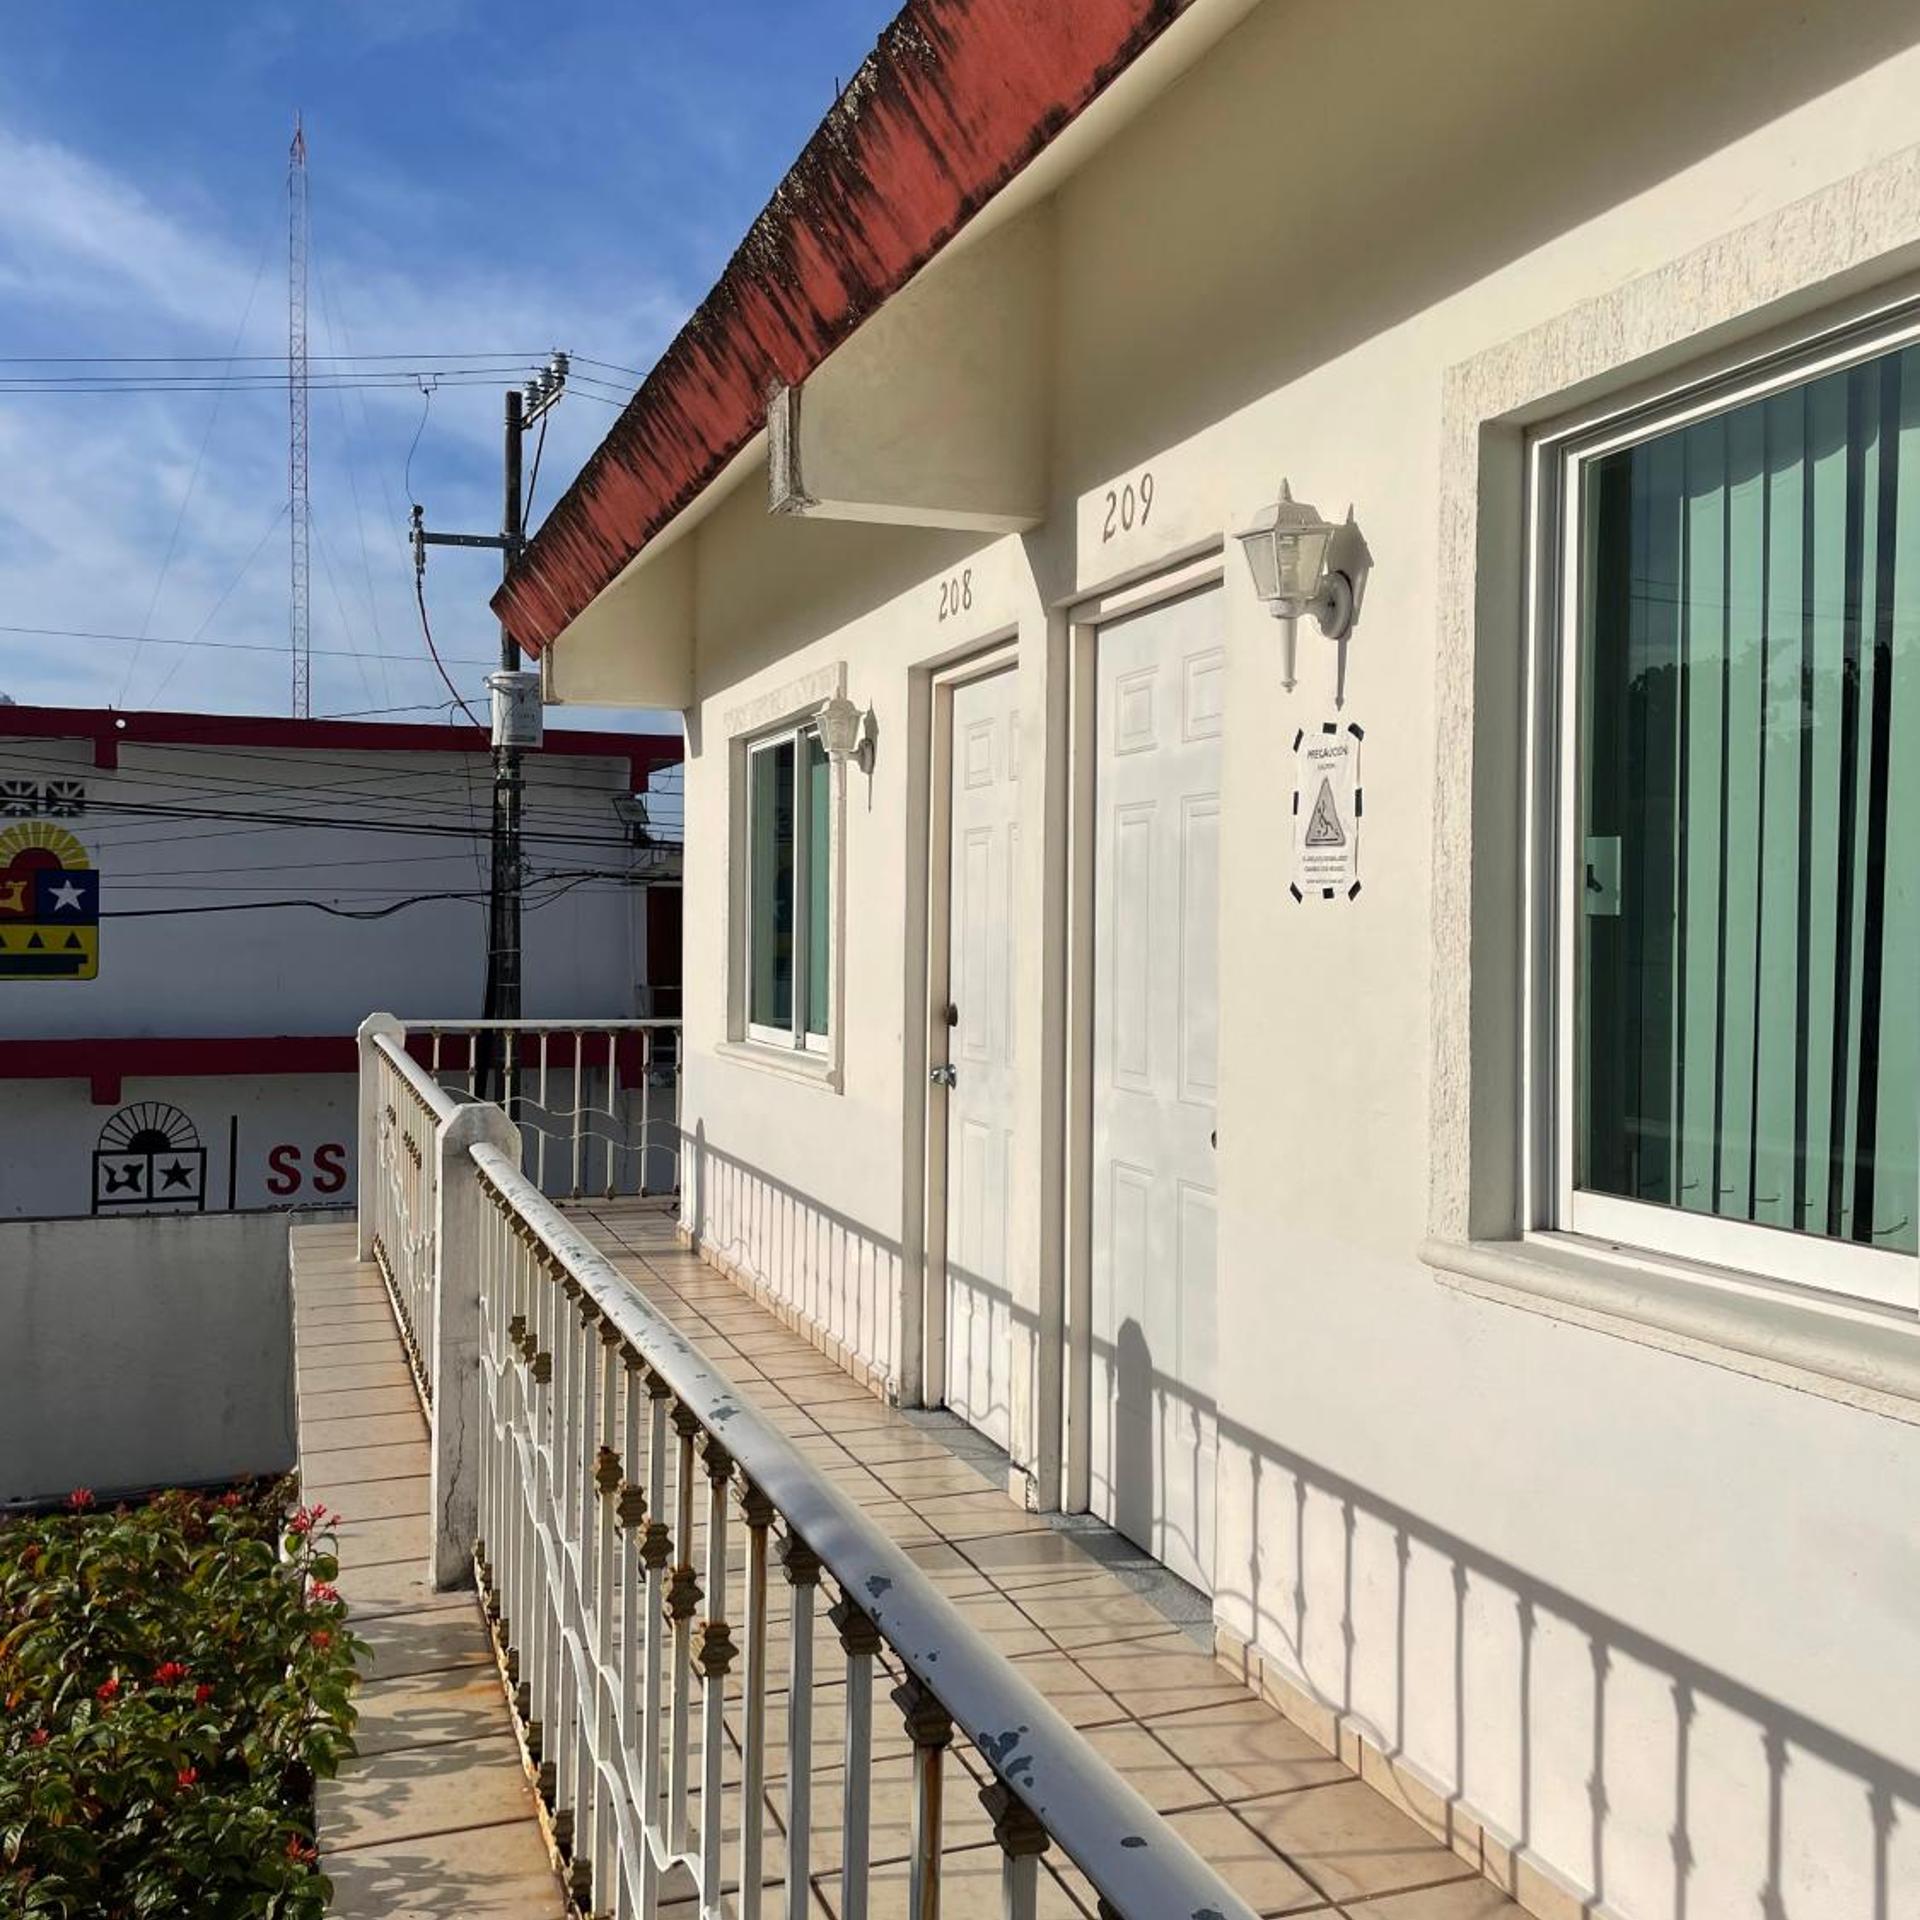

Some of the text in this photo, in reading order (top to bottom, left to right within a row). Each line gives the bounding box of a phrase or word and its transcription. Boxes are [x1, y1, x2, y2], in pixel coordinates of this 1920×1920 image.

[1103, 473, 1153, 544] 209
[939, 567, 972, 622] 208
[267, 1144, 347, 1196] SS
